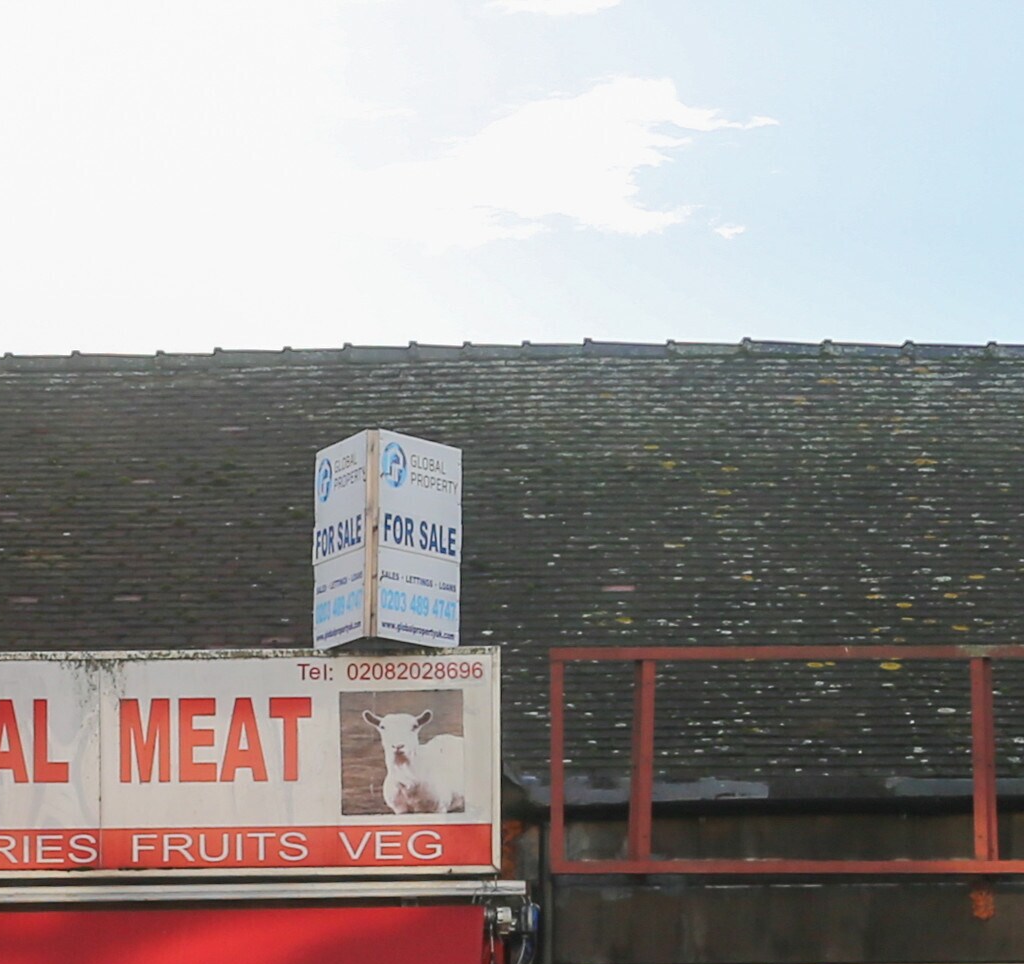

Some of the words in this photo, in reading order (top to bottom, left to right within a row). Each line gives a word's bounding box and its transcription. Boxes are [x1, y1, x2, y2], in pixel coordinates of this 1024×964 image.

[410, 455, 446, 475] GLOBAL
[410, 472, 458, 494] PROPERTY
[316, 525, 334, 559] FOR
[337, 514, 362, 551] SALE
[384, 513, 414, 547] FOR
[420, 521, 456, 557] SALE
[297, 663, 334, 681] Tel:
[346, 661, 484, 681] 02082028696
[119, 696, 312, 783] MEAT
[131, 831, 309, 864] FRUITS
[339, 829, 444, 861] VEG
